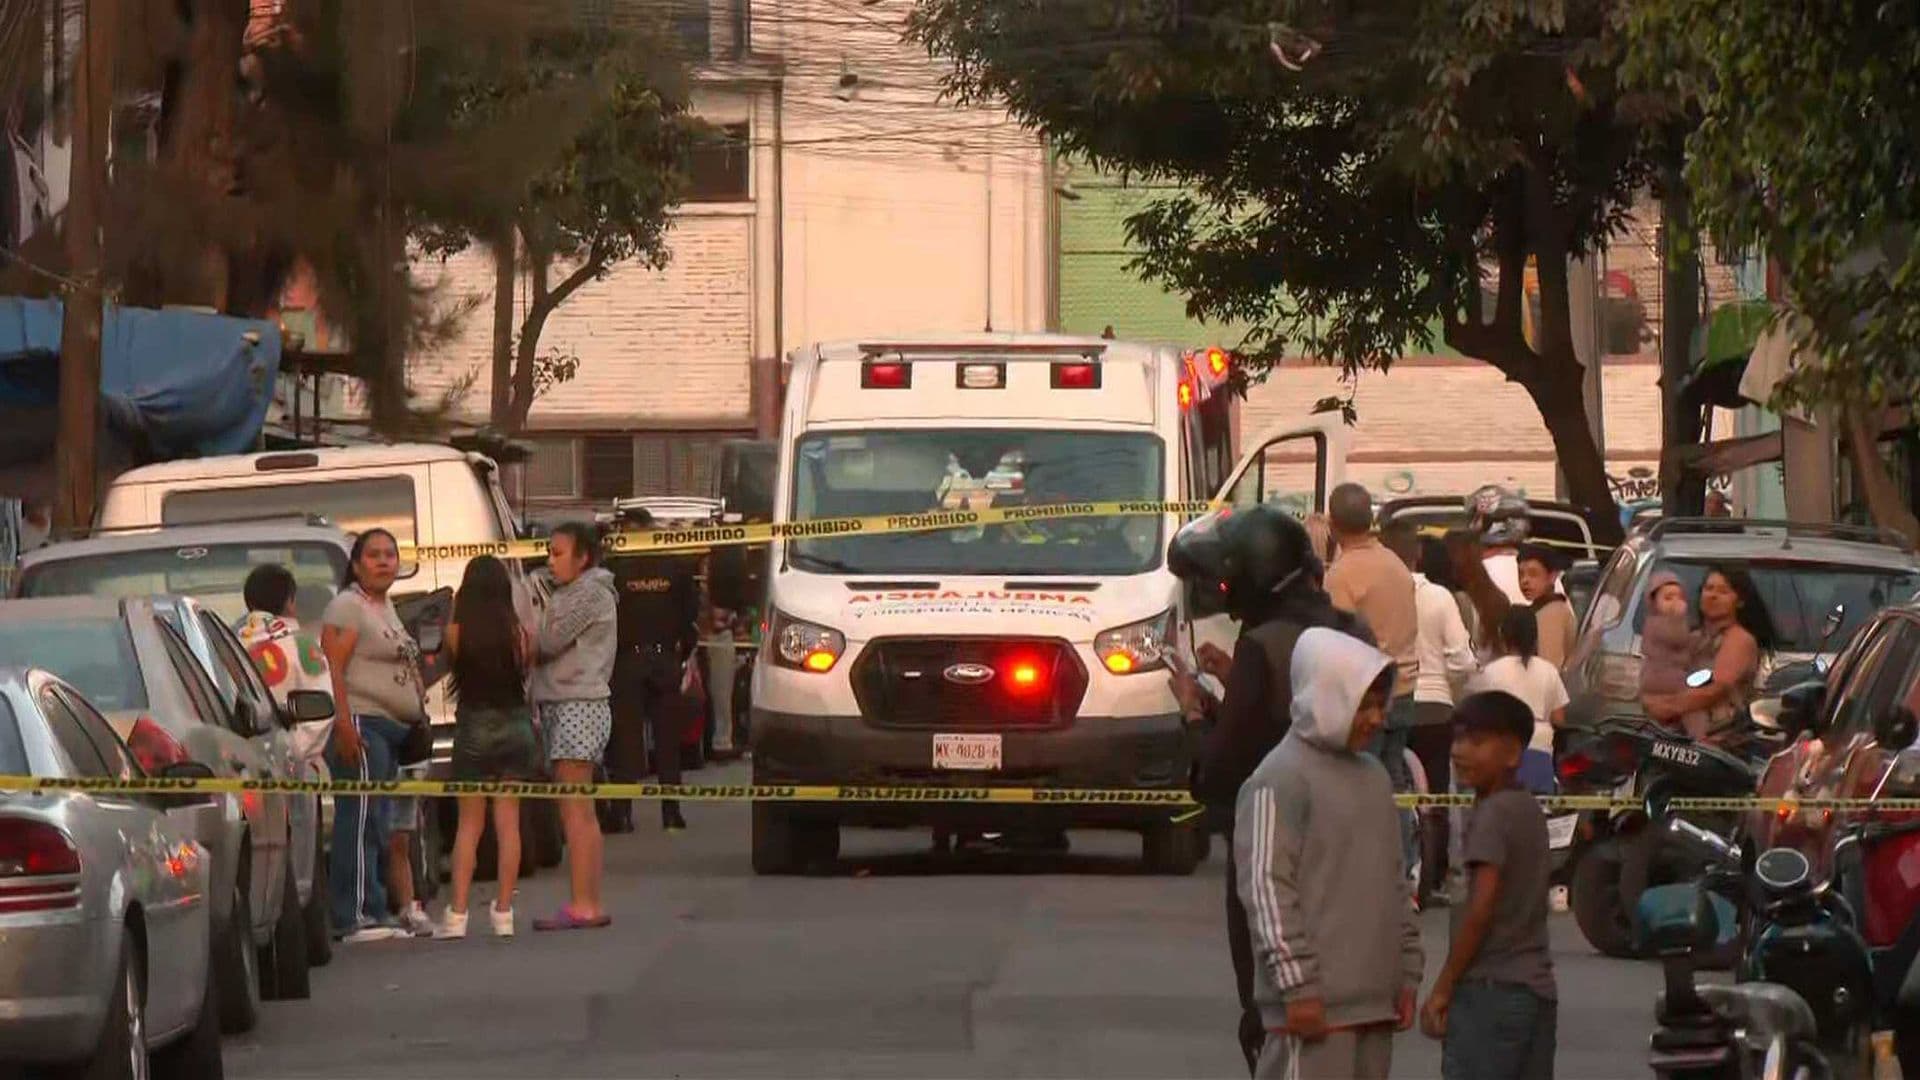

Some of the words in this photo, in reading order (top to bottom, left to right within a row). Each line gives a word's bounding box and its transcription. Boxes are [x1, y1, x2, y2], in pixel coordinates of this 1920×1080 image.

[416, 543, 509, 560] PROHIBIDO
[653, 527, 746, 545] PROHIBIDO
[771, 519, 863, 537] PROHIBIDO
[887, 511, 978, 529] PROHIBIDO
[1003, 503, 1094, 520] PROHIBIDO
[1119, 501, 1209, 514] PROHIBIDO
